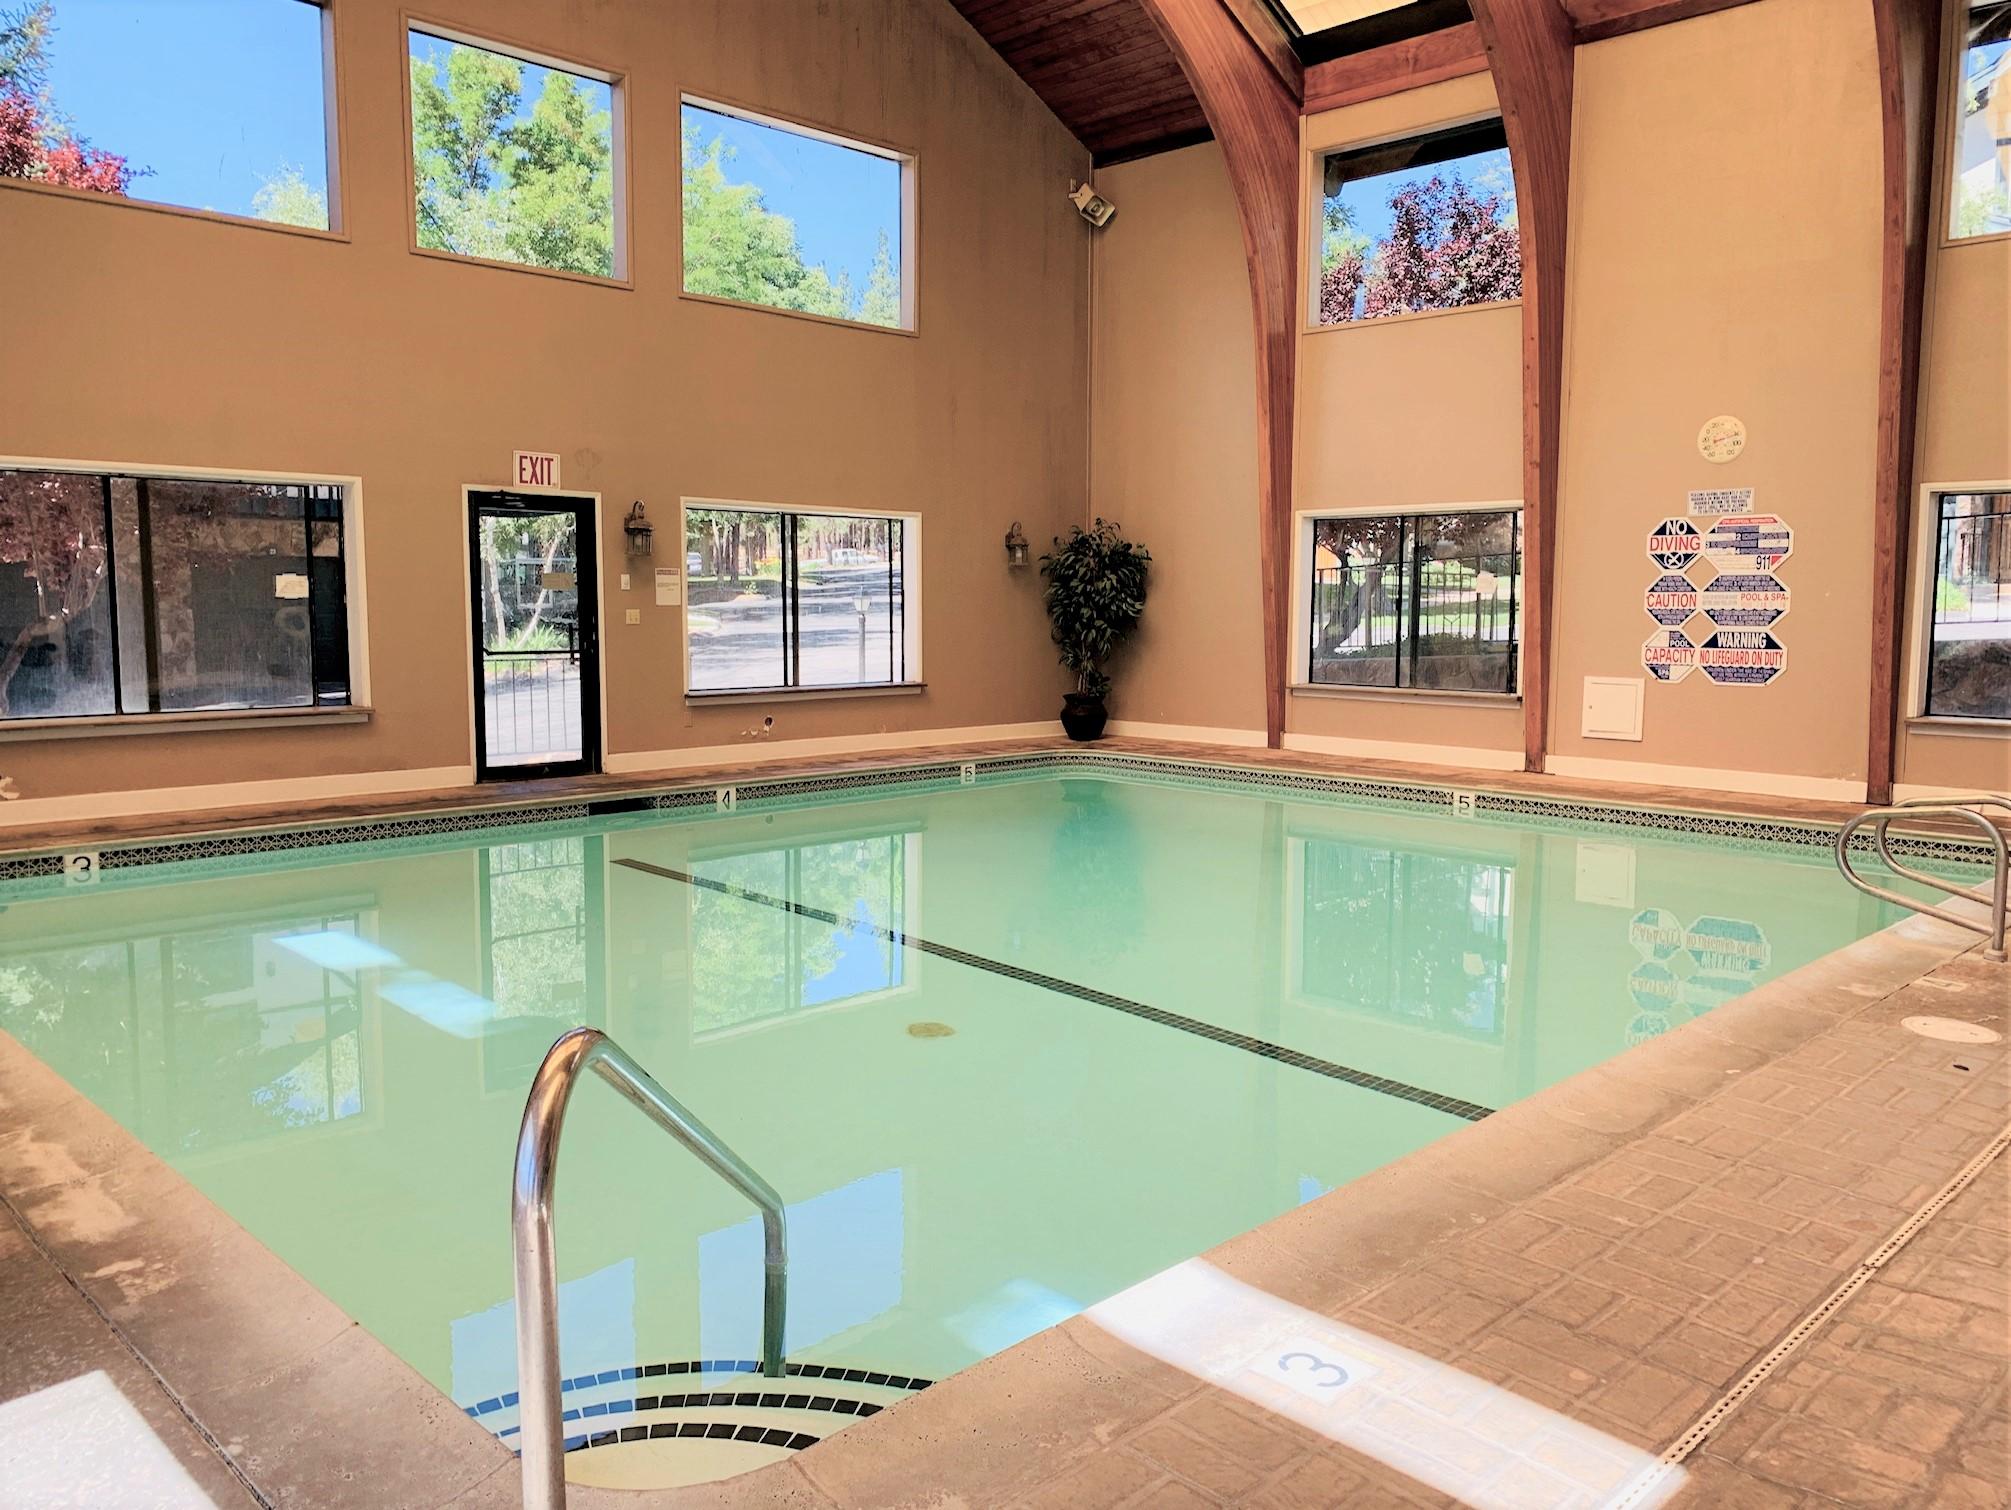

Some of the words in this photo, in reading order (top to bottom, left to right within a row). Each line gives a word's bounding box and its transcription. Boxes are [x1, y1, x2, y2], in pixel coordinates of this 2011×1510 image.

[519, 455, 554, 486] EXIT
[1665, 520, 1688, 535] NO
[1650, 536, 1701, 551] DIVING
[1756, 556, 1771, 570] 911
[1647, 593, 1697, 608] CAUTION
[1740, 593, 1762, 601] POOL
[1763, 593, 1769, 601] &
[1771, 593, 1786, 602] SPA
[1670, 639, 1690, 647] POOL
[1717, 632, 1767, 649] WARNING
[1644, 649, 1695, 663] CAPACITY
[1699, 650, 1710, 664] NO
[1712, 650, 1750, 665] LIFEGUARD
[1751, 651, 1763, 665] ON
[1765, 651, 1784, 667] DUTY
[1459, 795, 1470, 811] 5
[72, 856, 92, 883] 3
[1278, 1352, 1349, 1387] 3
